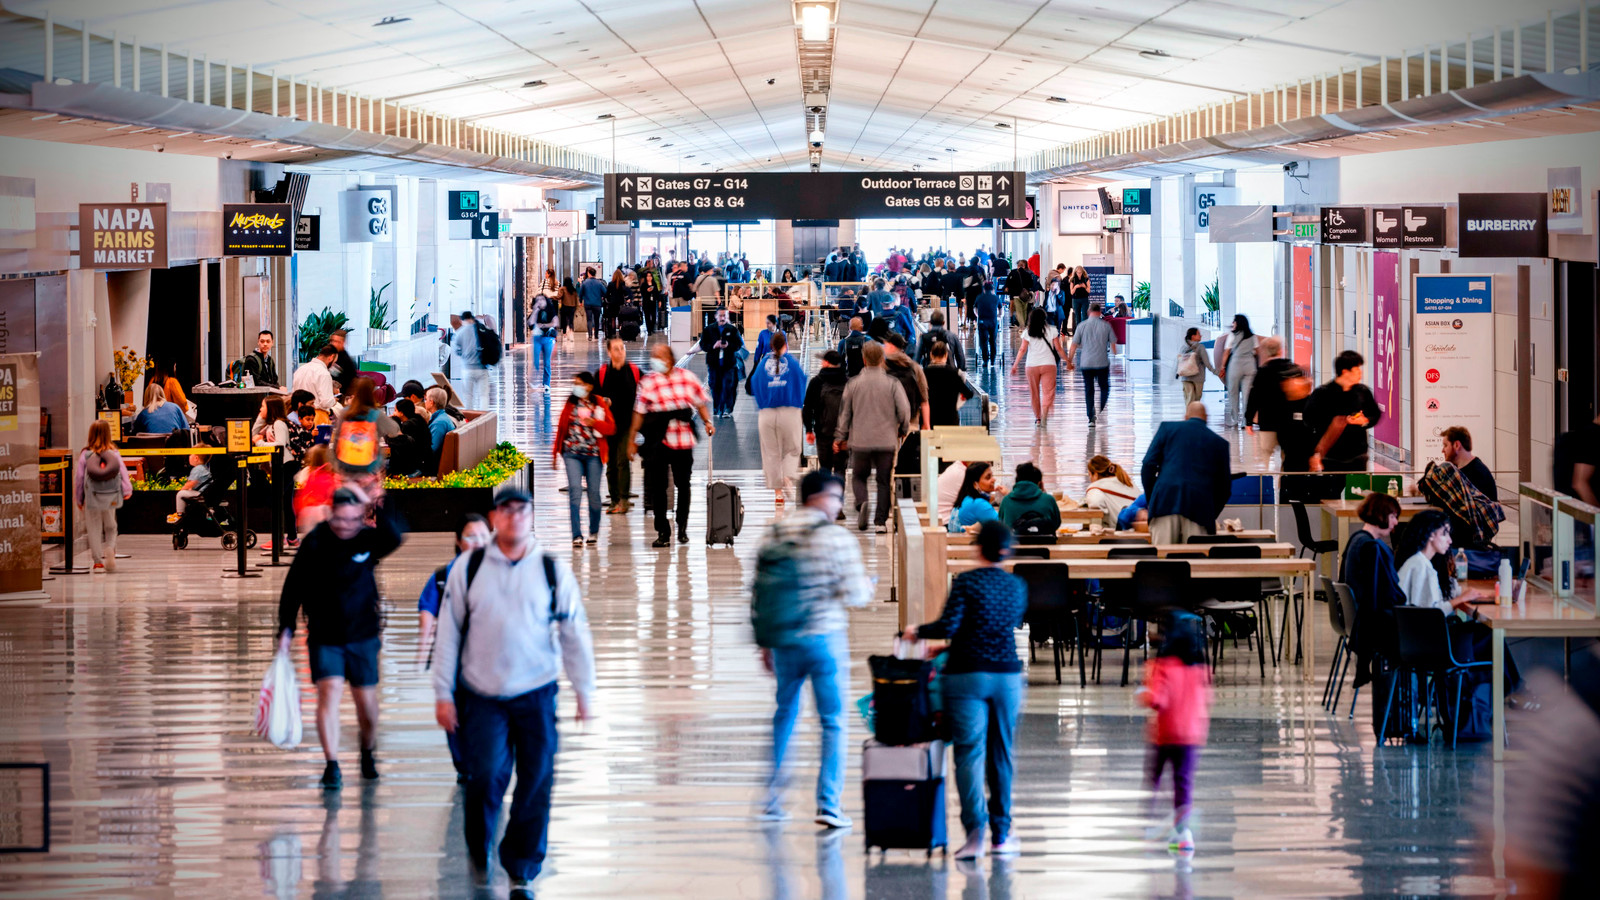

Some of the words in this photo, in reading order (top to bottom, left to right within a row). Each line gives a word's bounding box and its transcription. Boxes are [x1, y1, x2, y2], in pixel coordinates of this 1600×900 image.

[655, 178, 691, 190] Gates
[693, 178, 711, 190] G7
[723, 178, 748, 190] G14
[861, 177, 912, 189] Outdoor
[913, 177, 956, 189] Terrace
[368, 197, 387, 215] G3
[655, 196, 691, 208] Gates
[693, 196, 711, 208] G3
[713, 196, 725, 208] &
[727, 196, 745, 208] G4
[885, 195, 920, 207] Gates
[923, 195, 940, 207] G5
[943, 195, 954, 207] &
[957, 195, 975, 207] G6
[1198, 193, 1216, 209] G5
[93, 208, 154, 230] NAPA
[229, 212, 286, 229] Mustards
[1080, 211, 1098, 219] Club
[1198, 212, 1210, 228] G
[368, 218, 387, 235] G4
[1295, 224, 1314, 237] EXIT
[1467, 219, 1537, 231] BURBERRY
[94, 231, 155, 249] FARMS
[94, 250, 155, 263] MARKET
[1424, 297, 1454, 305] Shopping
[1462, 297, 1483, 305] Dining
